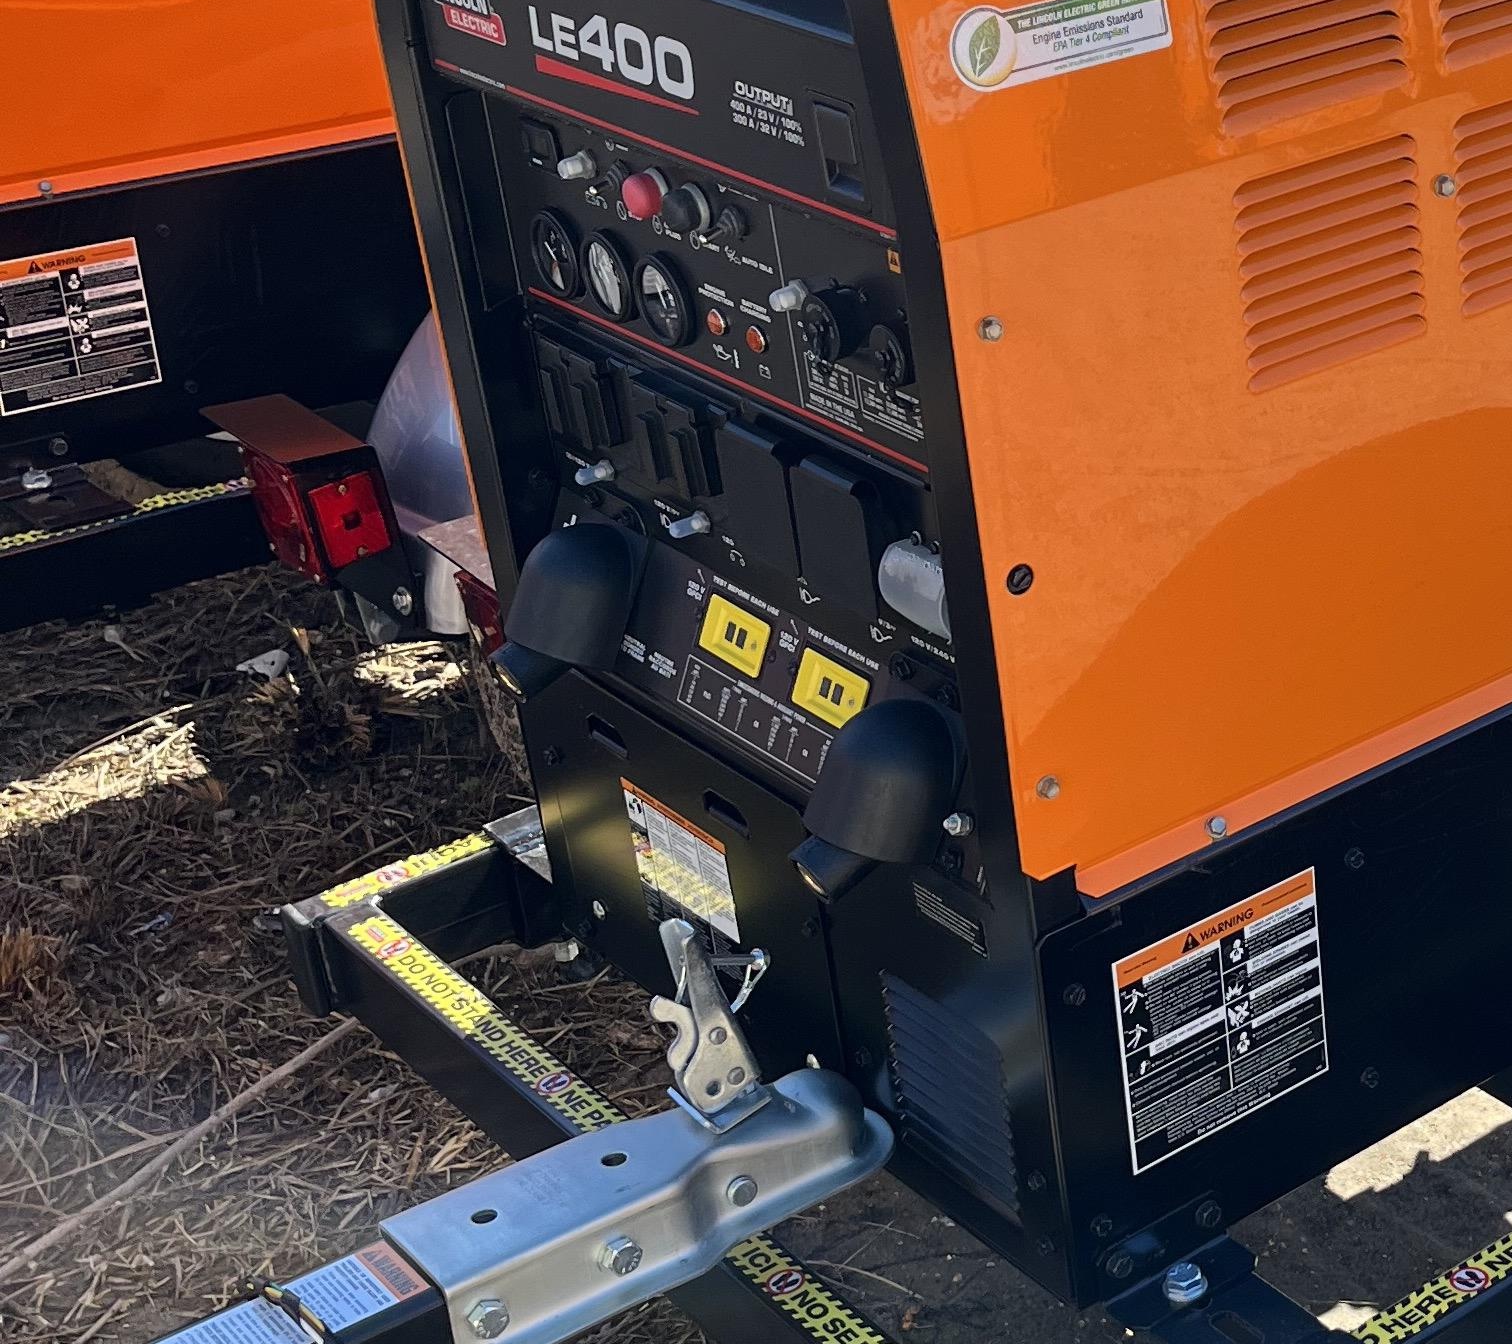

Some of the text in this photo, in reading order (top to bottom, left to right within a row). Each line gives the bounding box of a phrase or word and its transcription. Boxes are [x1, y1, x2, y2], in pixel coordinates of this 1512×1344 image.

[449, 8, 499, 39] ELECTRIC
[1016, 18, 1032, 30] THE
[1032, 9, 1064, 28] LINCOLN
[1064, 2, 1097, 19] ELECTRIC
[1032, 8, 1144, 46] Engine Emissions Standard
[528, 4, 695, 100] LE400
[1053, 24, 1130, 53] EPA Tier 4 Compliant
[41, 254, 86, 271] WARNING
[713, 574, 728, 588] TEST
[727, 582, 751, 601] BEFORE
[750, 594, 767, 610] EACH
[807, 626, 880, 671] TEST BEFORE EACH USE
[1199, 907, 1254, 942] WARNING
[397, 954, 551, 1080] DO NOT STAND HERE
[557, 1088, 593, 1115] NE
[371, 1248, 419, 1297] WARNING
[741, 1246, 777, 1275] ICI
[789, 1288, 830, 1320] NO
[1379, 1285, 1458, 1338] HERE
